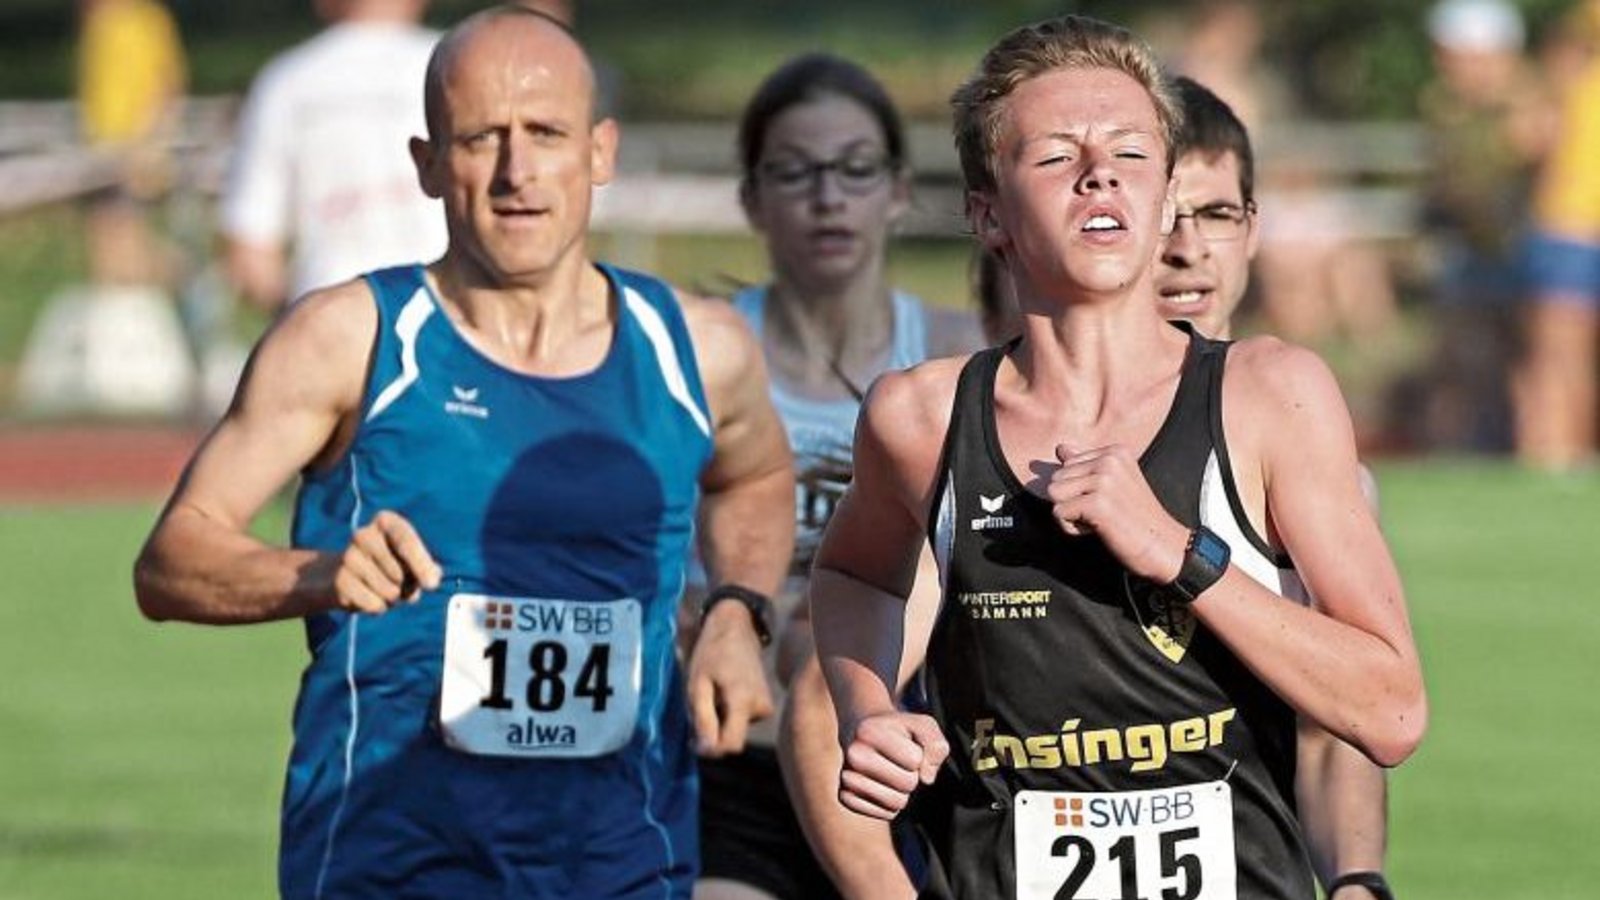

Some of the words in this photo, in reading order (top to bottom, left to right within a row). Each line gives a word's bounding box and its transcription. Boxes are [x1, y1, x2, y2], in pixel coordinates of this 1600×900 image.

[971, 515, 1014, 530] erima
[480, 639, 613, 712] 184
[507, 716, 576, 745] alwa
[972, 708, 1237, 772] Ensinger
[1051, 827, 1202, 900] 215
